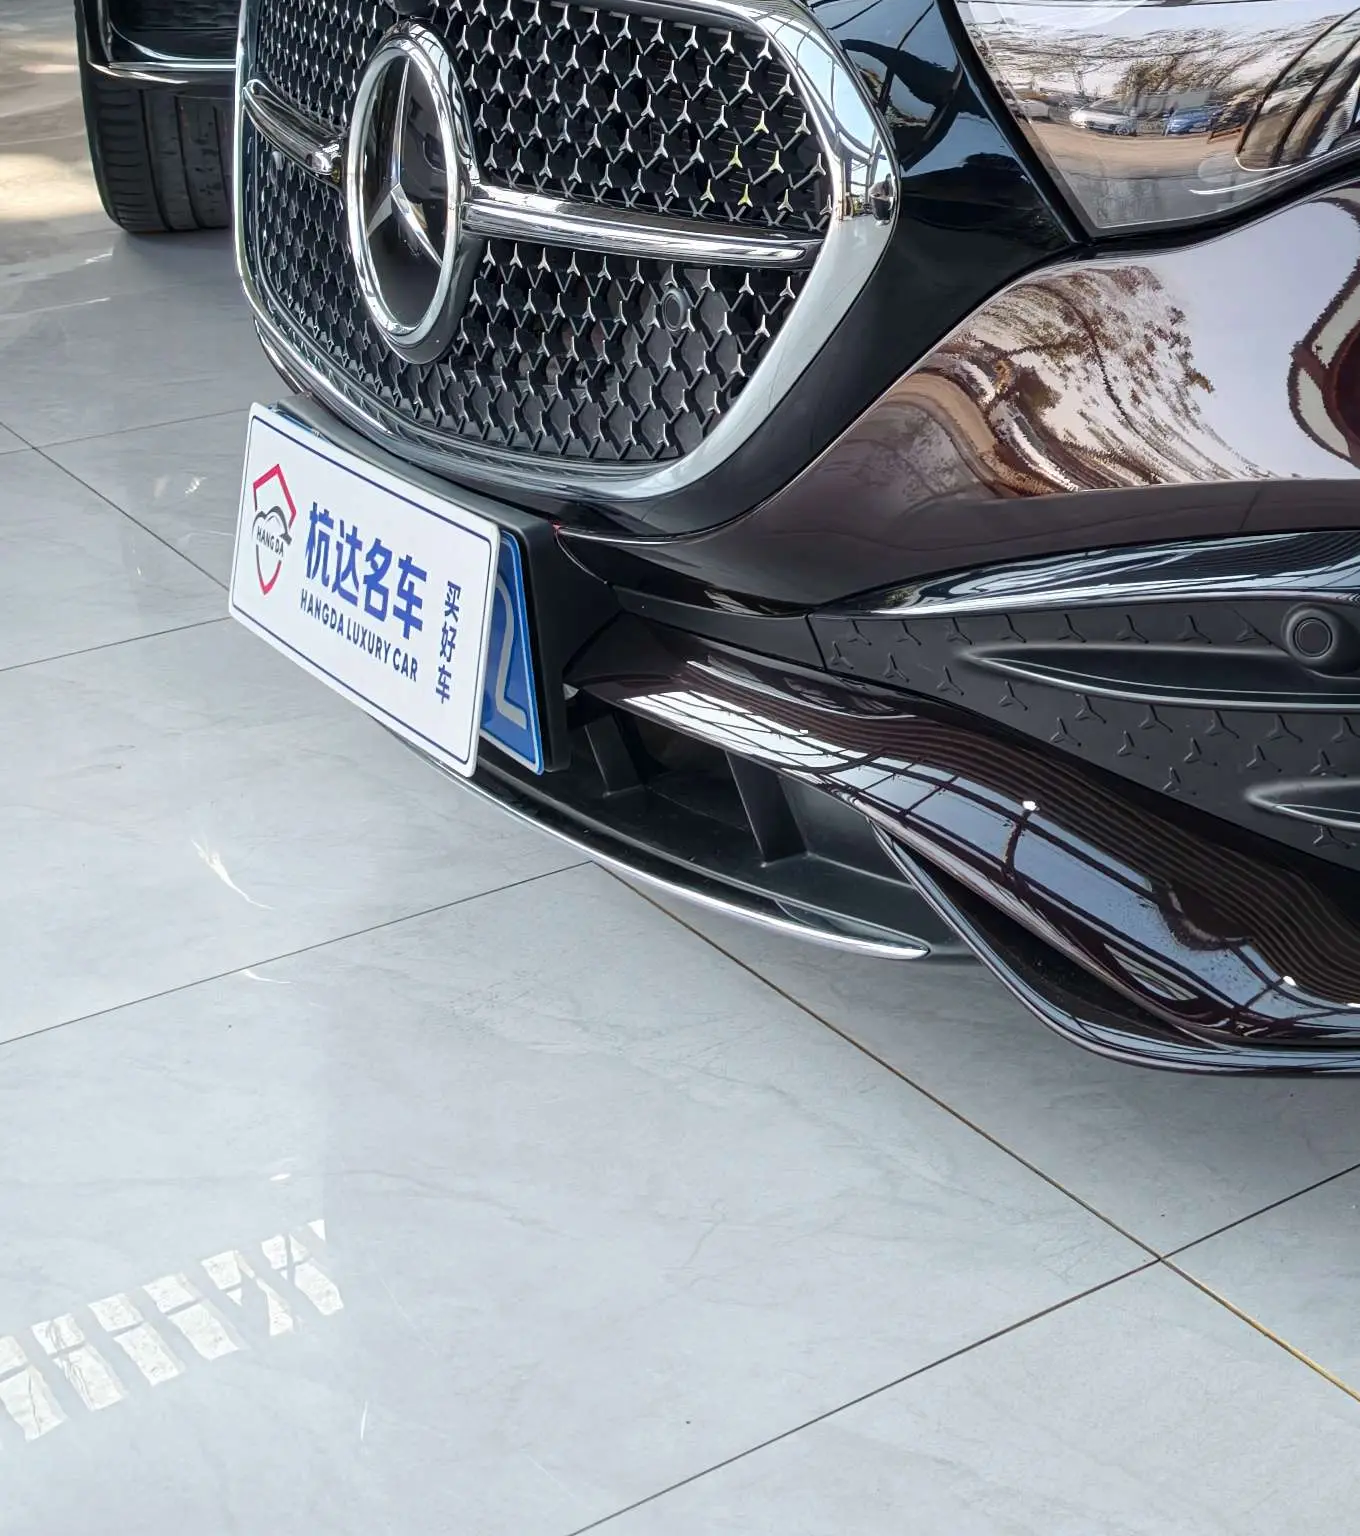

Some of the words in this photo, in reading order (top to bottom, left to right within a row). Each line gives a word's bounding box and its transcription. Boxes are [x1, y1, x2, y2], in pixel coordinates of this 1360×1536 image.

[305, 502, 428, 640] 杭达名车
[300, 588, 344, 635] HANGDA
[346, 622, 392, 665] LUXURY
[392, 648, 418, 683] CAR
[435, 580, 462, 704] 买好车
